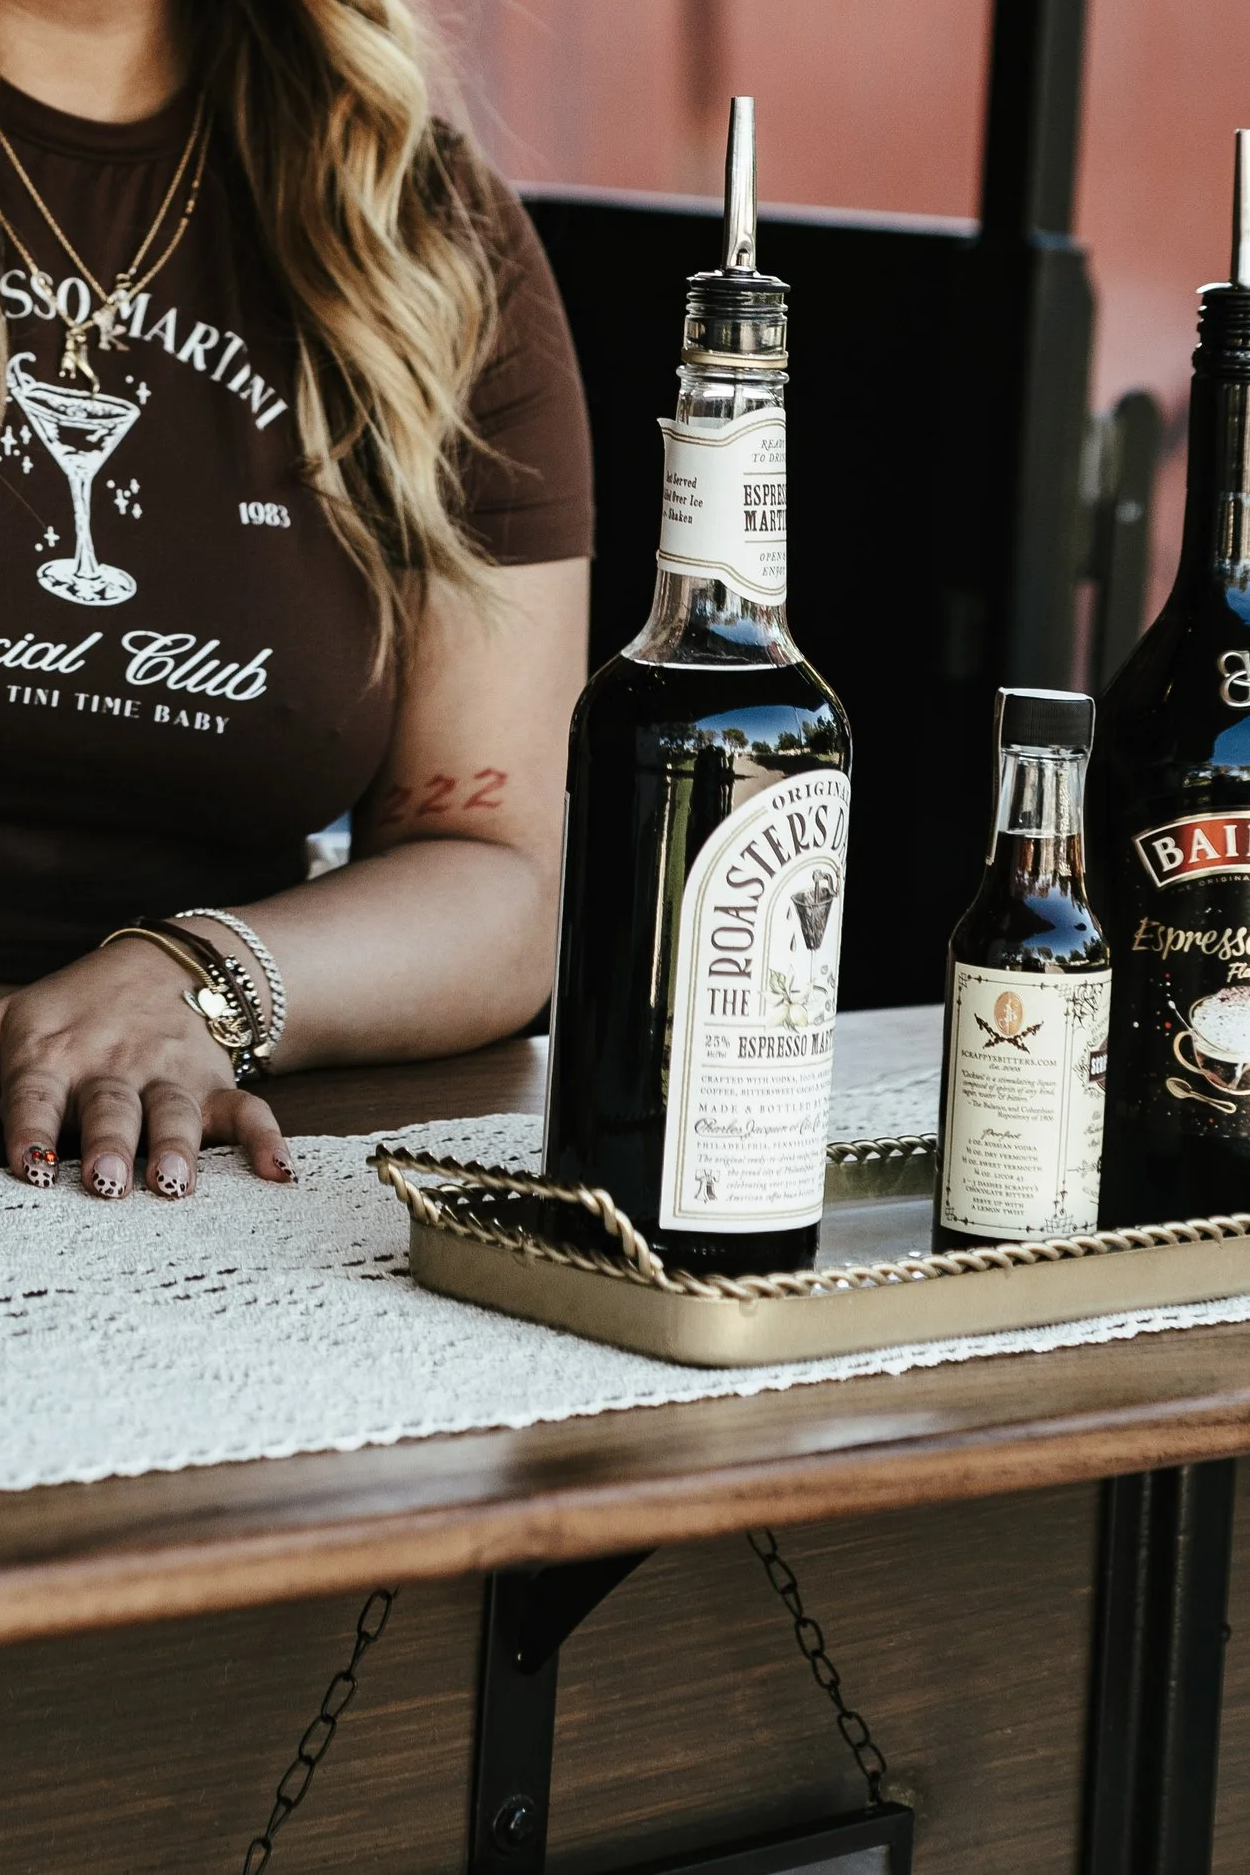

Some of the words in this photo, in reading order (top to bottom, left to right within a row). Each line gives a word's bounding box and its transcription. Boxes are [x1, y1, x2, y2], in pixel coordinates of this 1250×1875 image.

[115, 289, 288, 430] MARTINI
[238, 501, 291, 529] 1983
[690, 494, 704, 508] Ice
[121, 630, 273, 701] Club
[7, 685, 59, 707] TINI
[74, 693, 141, 718] TIME
[154, 704, 229, 734] BABY
[707, 987, 751, 1017] THE
[738, 1034, 808, 1059] ESPRESSO
[698, 1103, 737, 1114] MADE
